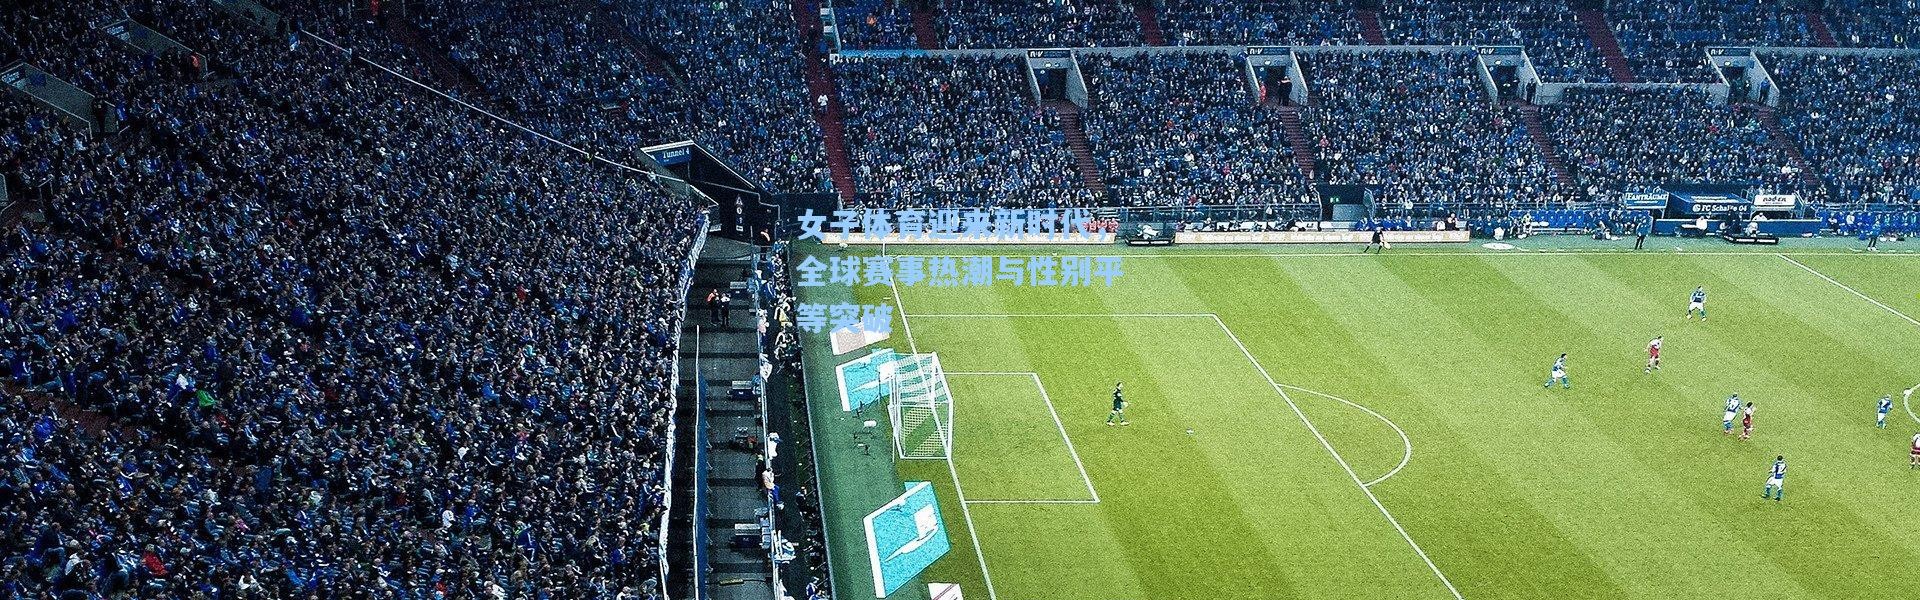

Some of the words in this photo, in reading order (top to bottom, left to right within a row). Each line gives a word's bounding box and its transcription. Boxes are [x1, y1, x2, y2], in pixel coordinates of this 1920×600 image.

[662, 149, 685, 159] Tunnel
[1701, 204, 1711, 212] FC
[1738, 204, 1747, 212] 04
